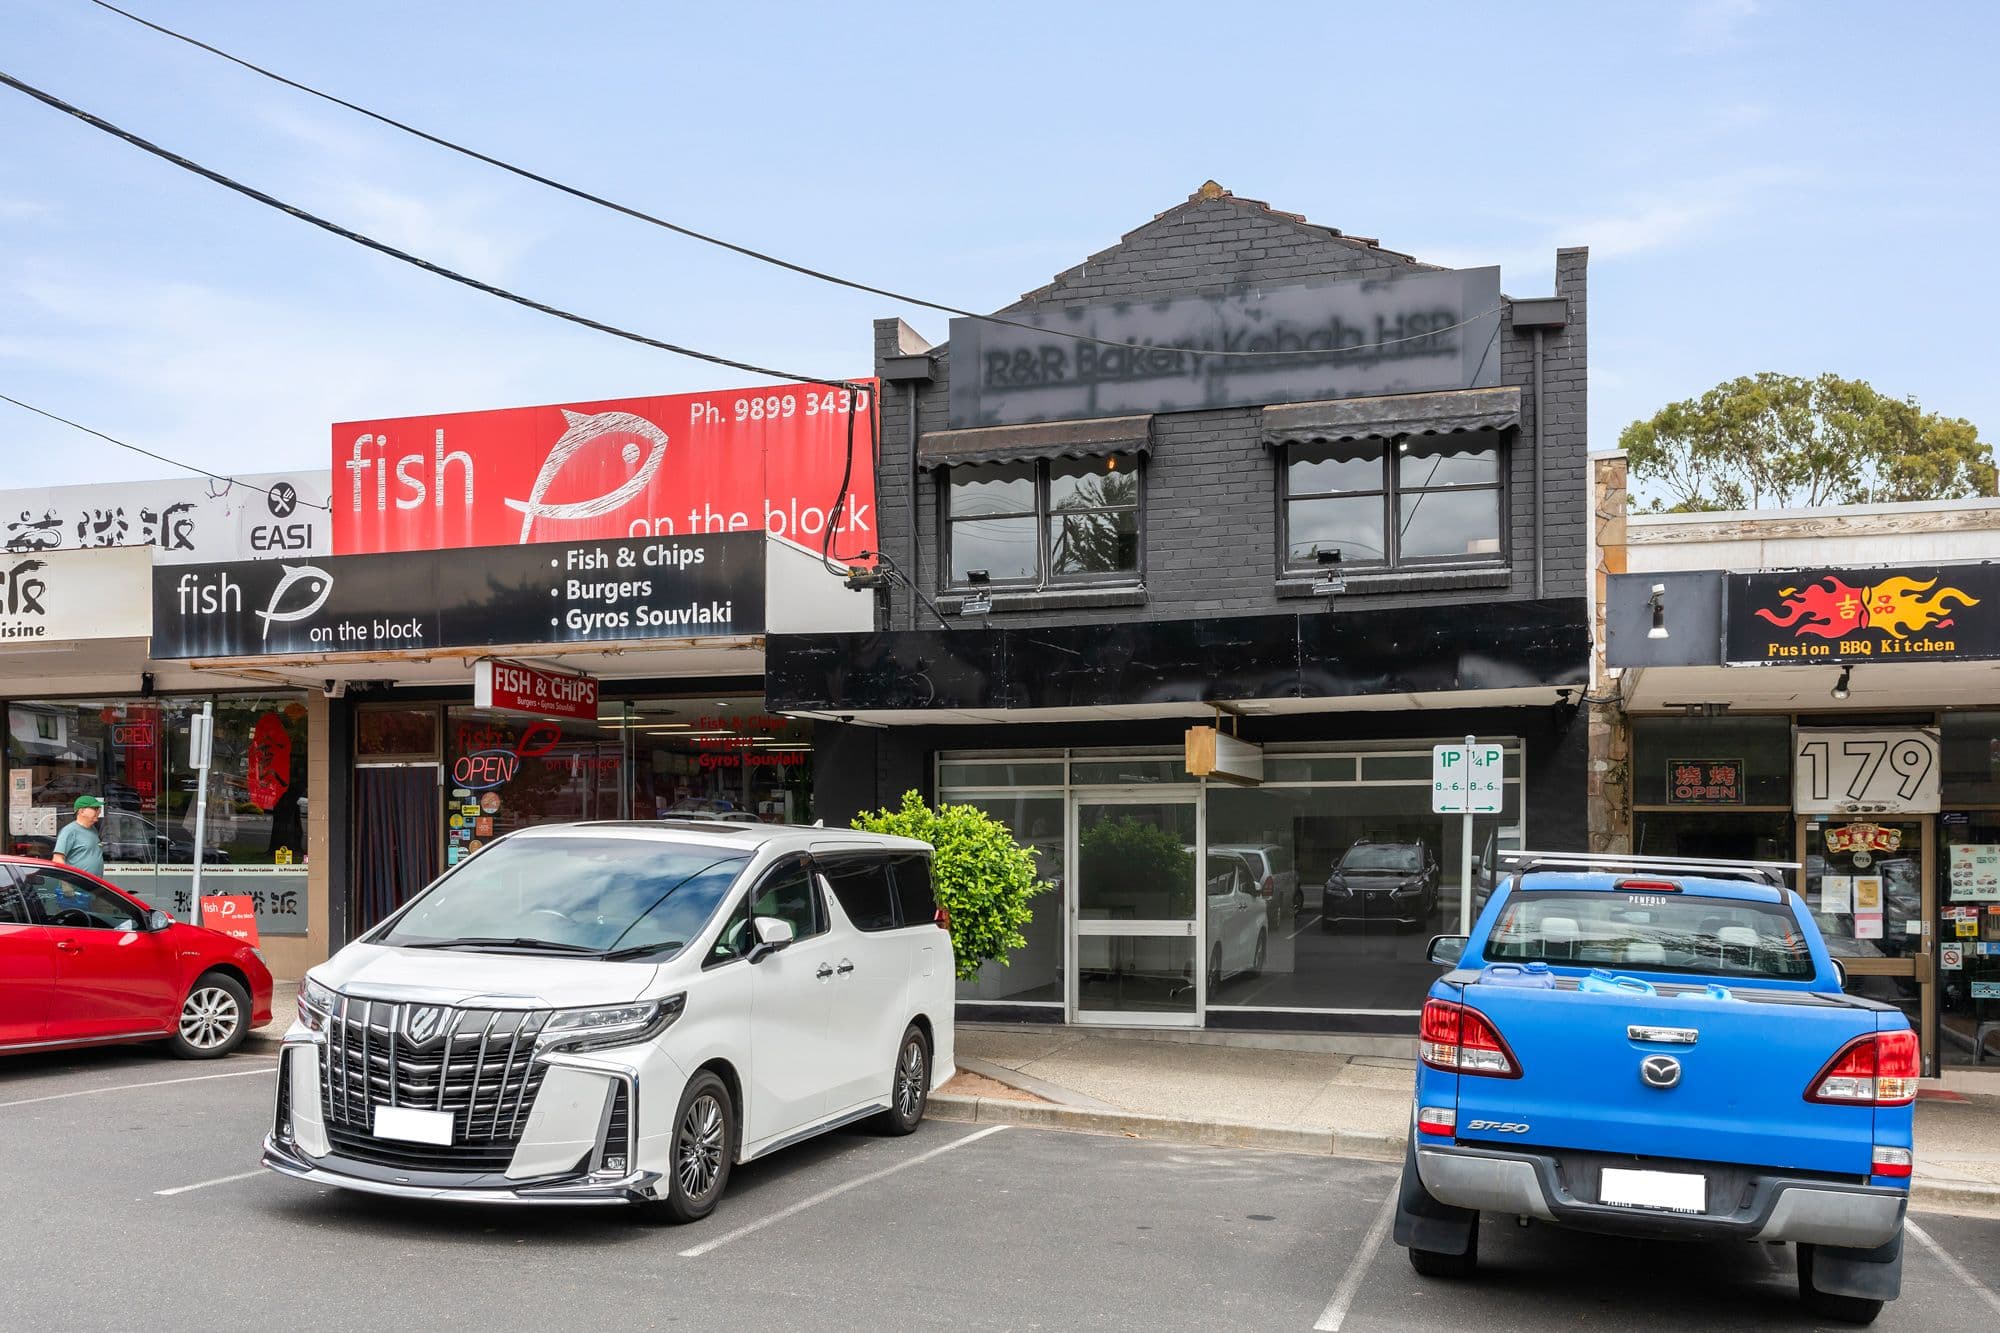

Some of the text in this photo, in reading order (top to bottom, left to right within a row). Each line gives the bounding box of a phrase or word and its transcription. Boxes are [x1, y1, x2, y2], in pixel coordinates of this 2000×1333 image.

[690, 391, 869, 424] Ph. 9899 3430
[345, 429, 474, 512] fish
[628, 516, 675, 538] on
[688, 503, 749, 534] the
[250, 524, 312, 550] EASI
[566, 543, 705, 571] Fish & Chips
[177, 572, 241, 615] fish
[566, 579, 652, 604] Burgers
[566, 600, 732, 635] Gyros Souvlaki
[1835, 593, 1896, 619] 吉 品
[310, 618, 423, 642] on the block
[1768, 638, 1955, 657] Fusion BBQ Kitchen
[495, 667, 595, 704] FISH & CHIPS
[517, 697, 576, 712] Burgers Gyros Souvlaki
[700, 716, 728, 729] Fish
[114, 727, 152, 744] OPEN
[458, 720, 501, 751] fish
[453, 757, 514, 782] OPEN
[699, 752, 805, 771] Gyros Souvlaki
[1441, 751, 1461, 767] 1P
[1800, 739, 1933, 800] 179
[1675, 786, 1736, 798] OPEN
[204, 902, 219, 913] fish
[1629, 895, 1666, 905] PENFOLD
[233, 930, 248, 938] Chips
[1467, 1119, 1530, 1134] BT-50
